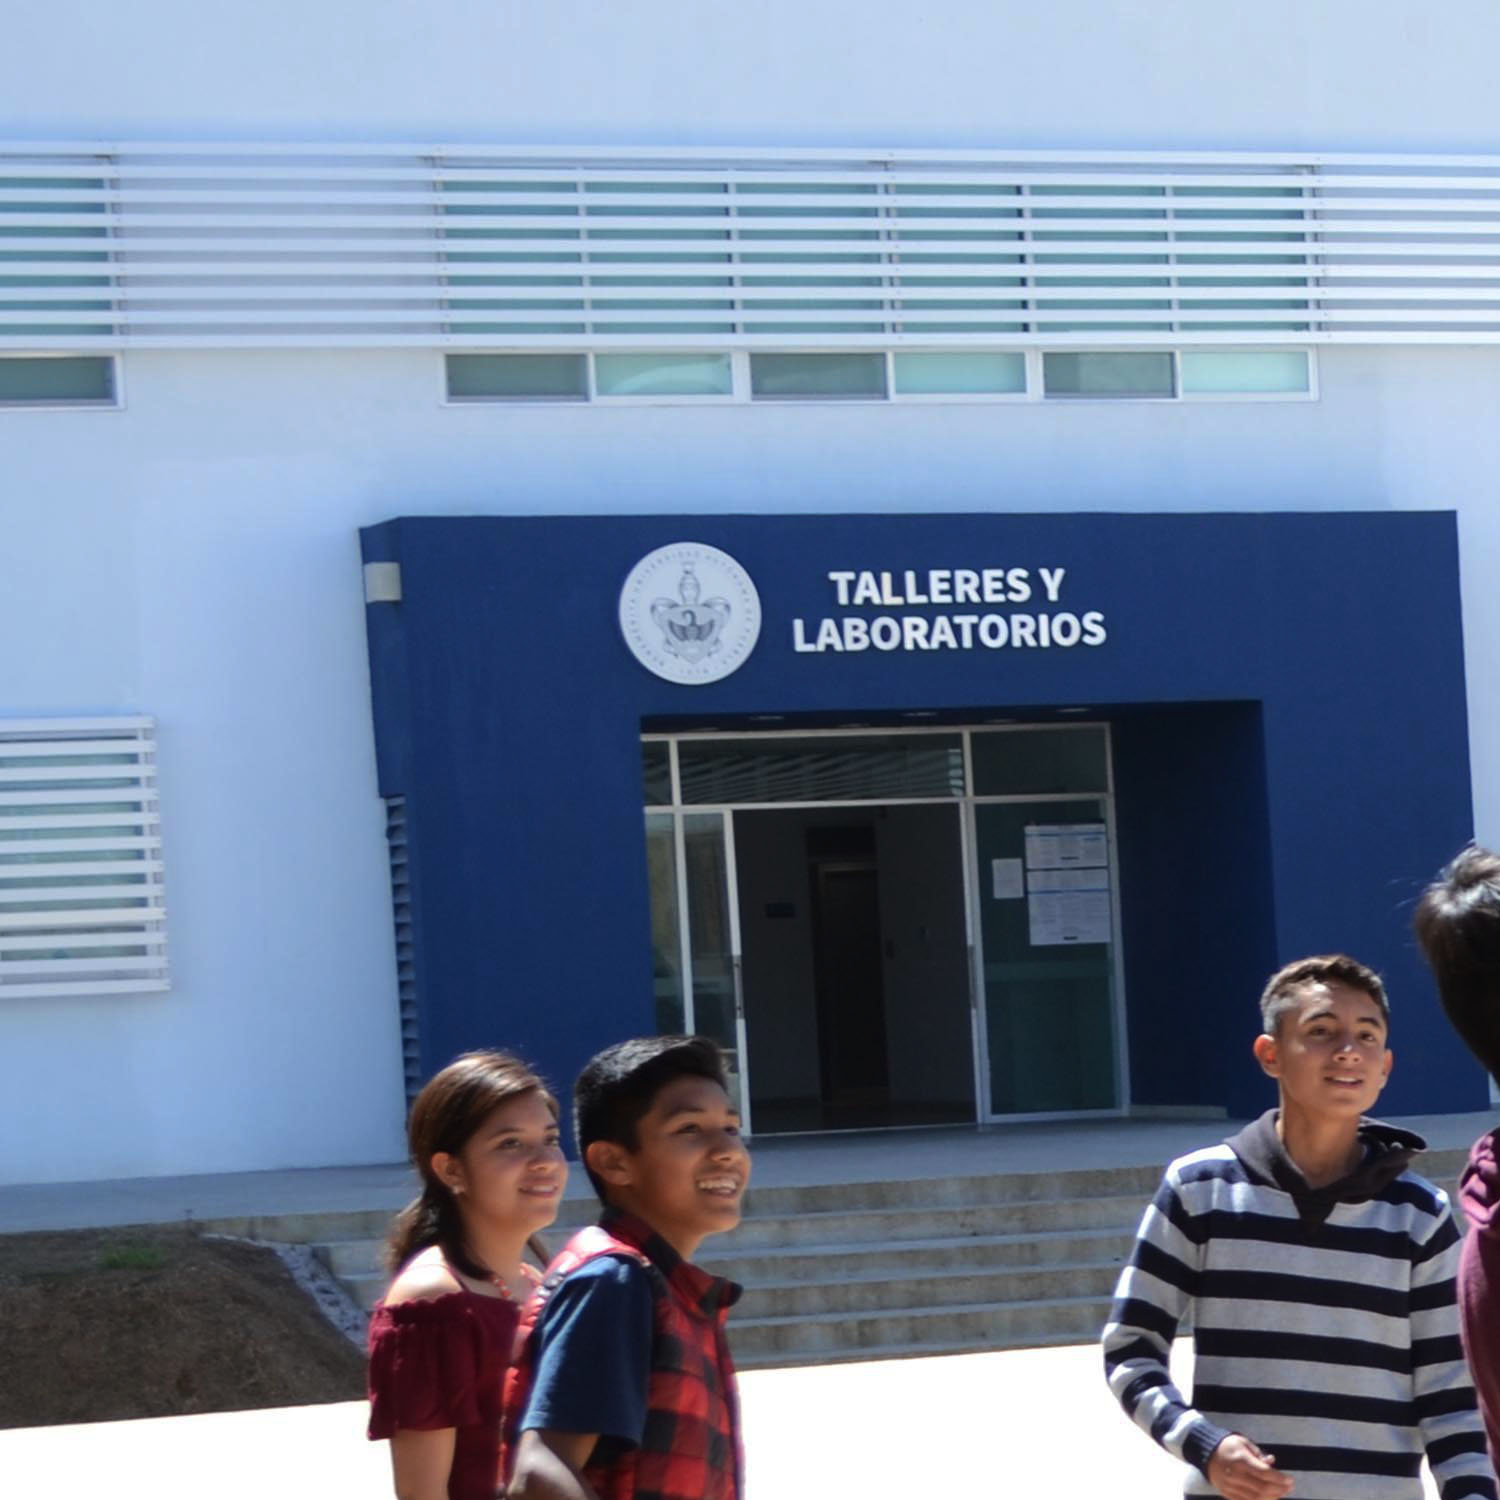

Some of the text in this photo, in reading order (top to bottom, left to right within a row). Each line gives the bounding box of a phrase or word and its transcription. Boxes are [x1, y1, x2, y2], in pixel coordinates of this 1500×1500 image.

[828, 567, 1065, 606] TALLERES Y
[793, 611, 1107, 653] LABORATORIOS
